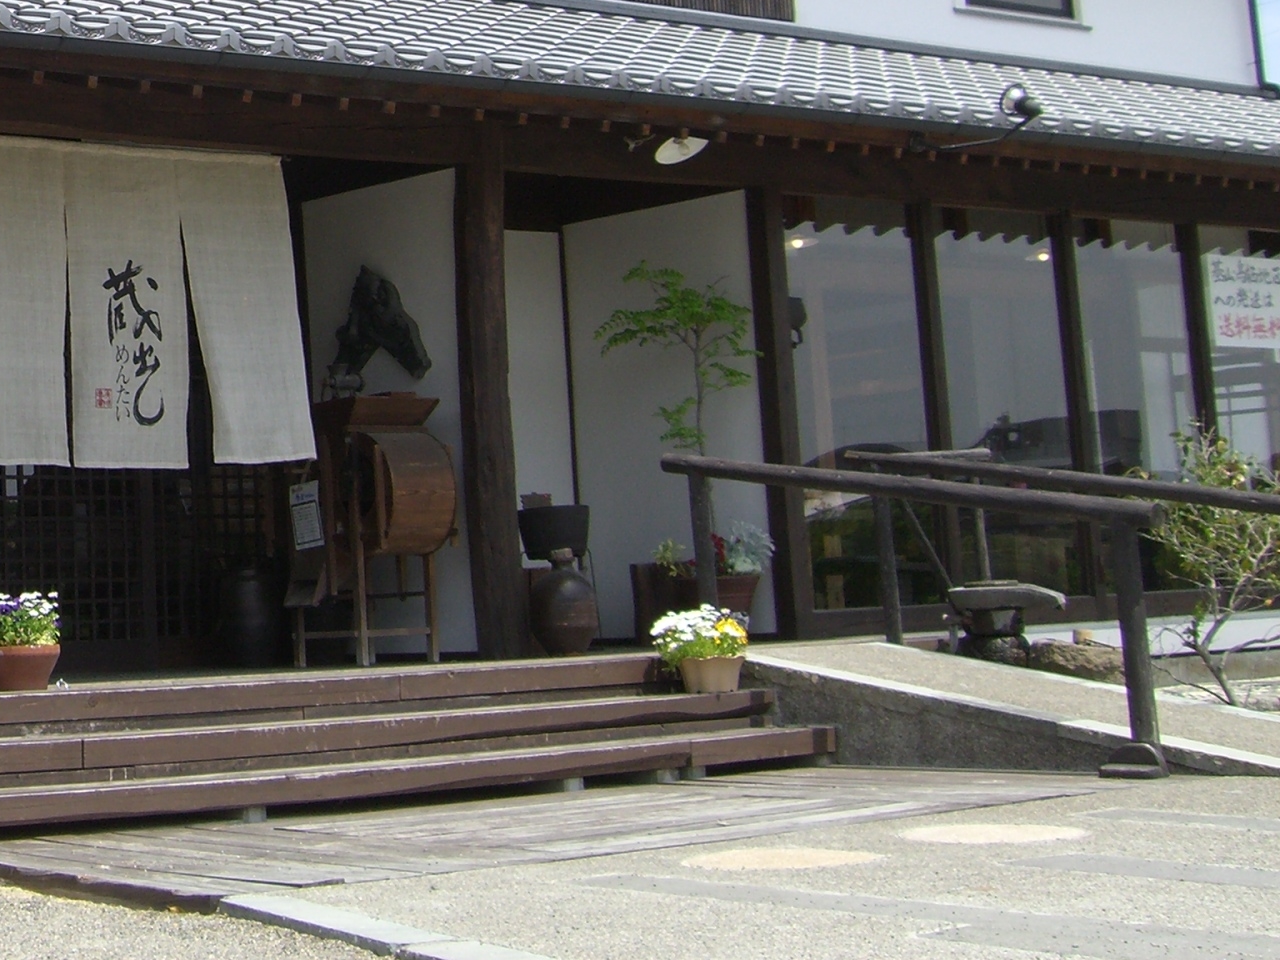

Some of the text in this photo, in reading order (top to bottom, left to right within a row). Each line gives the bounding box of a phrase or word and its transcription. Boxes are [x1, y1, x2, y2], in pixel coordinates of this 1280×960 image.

[1214, 287, 1274, 309] への発送は
[102, 259, 165, 427] 蔵出し
[1219, 312, 1280, 340] 送料無料
[115, 345, 131, 422] めんたい
